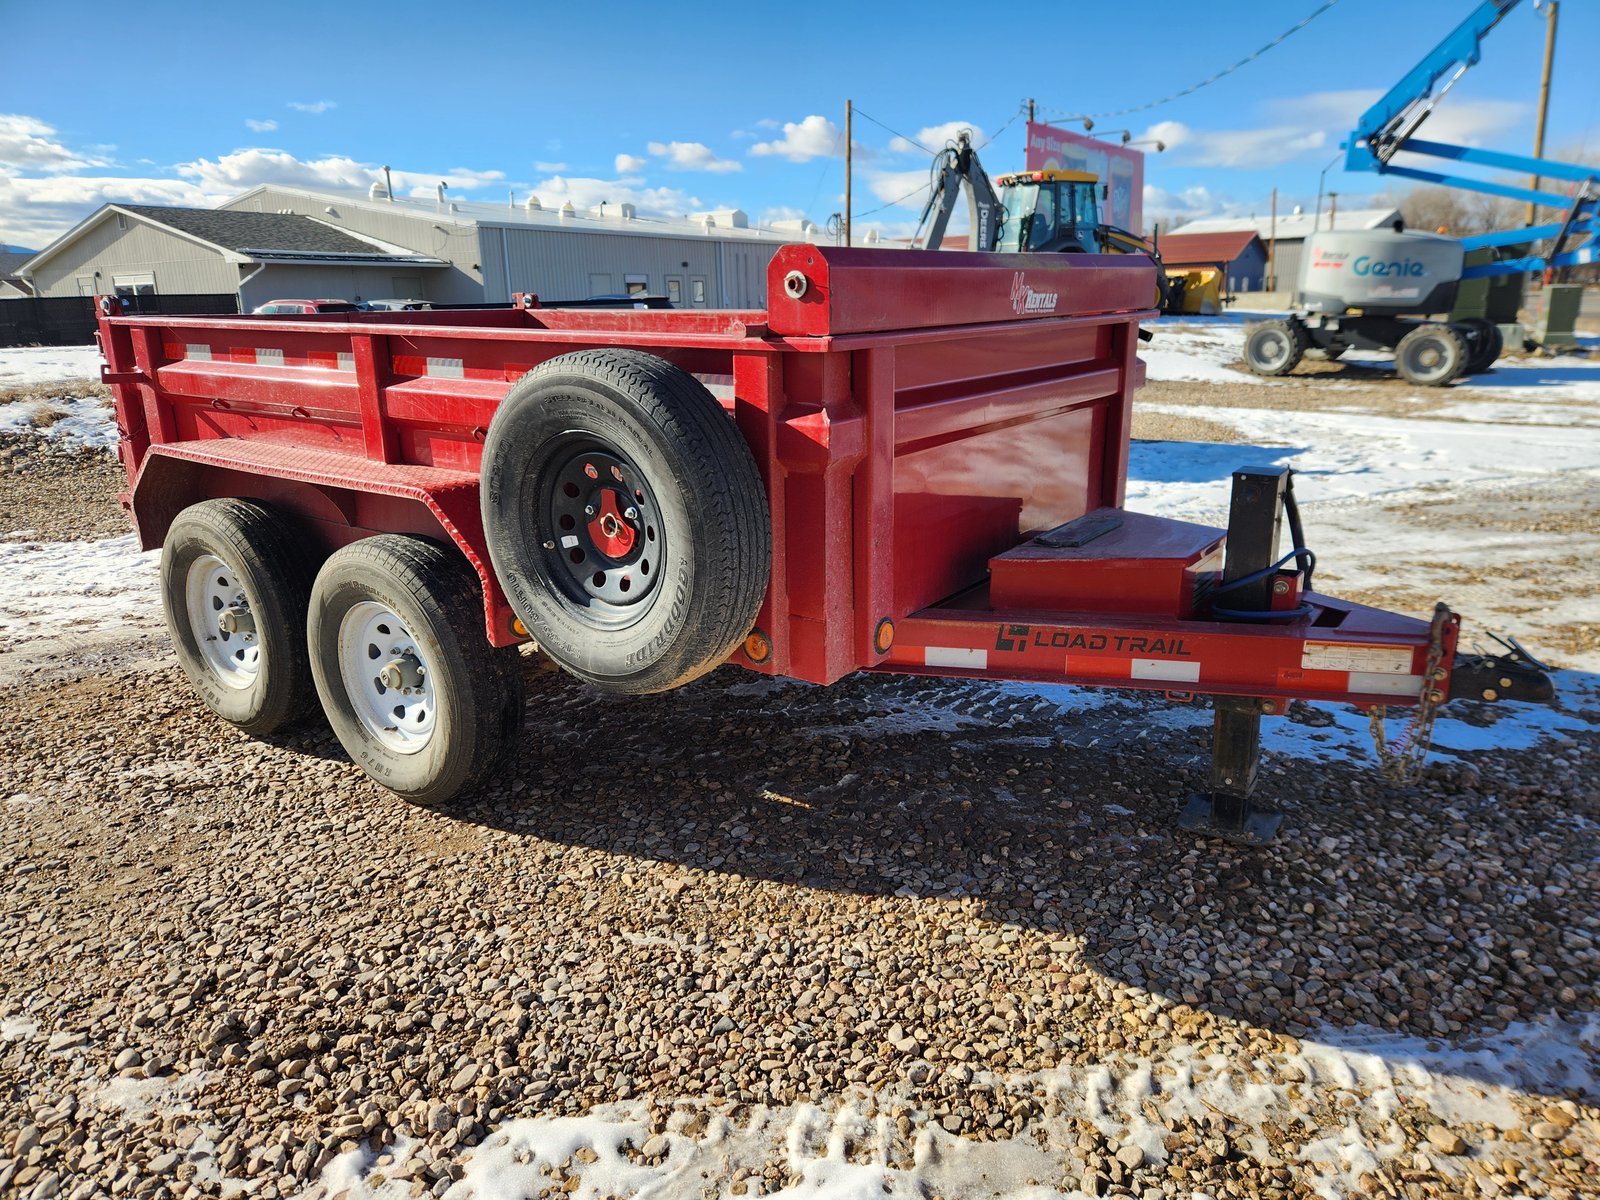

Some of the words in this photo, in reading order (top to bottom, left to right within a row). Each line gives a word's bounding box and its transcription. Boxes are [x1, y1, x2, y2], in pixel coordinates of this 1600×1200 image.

[1031, 134, 1045, 153] Any
[1046, 136, 1061, 153] Size
[979, 209, 990, 249] DEERE
[1353, 256, 1424, 277] Genie
[1025, 289, 1058, 309] RENTALS
[625, 567, 689, 668] GOODRIDE
[1034, 631, 1108, 650] LOAD
[1113, 635, 1192, 656] TRAIL
